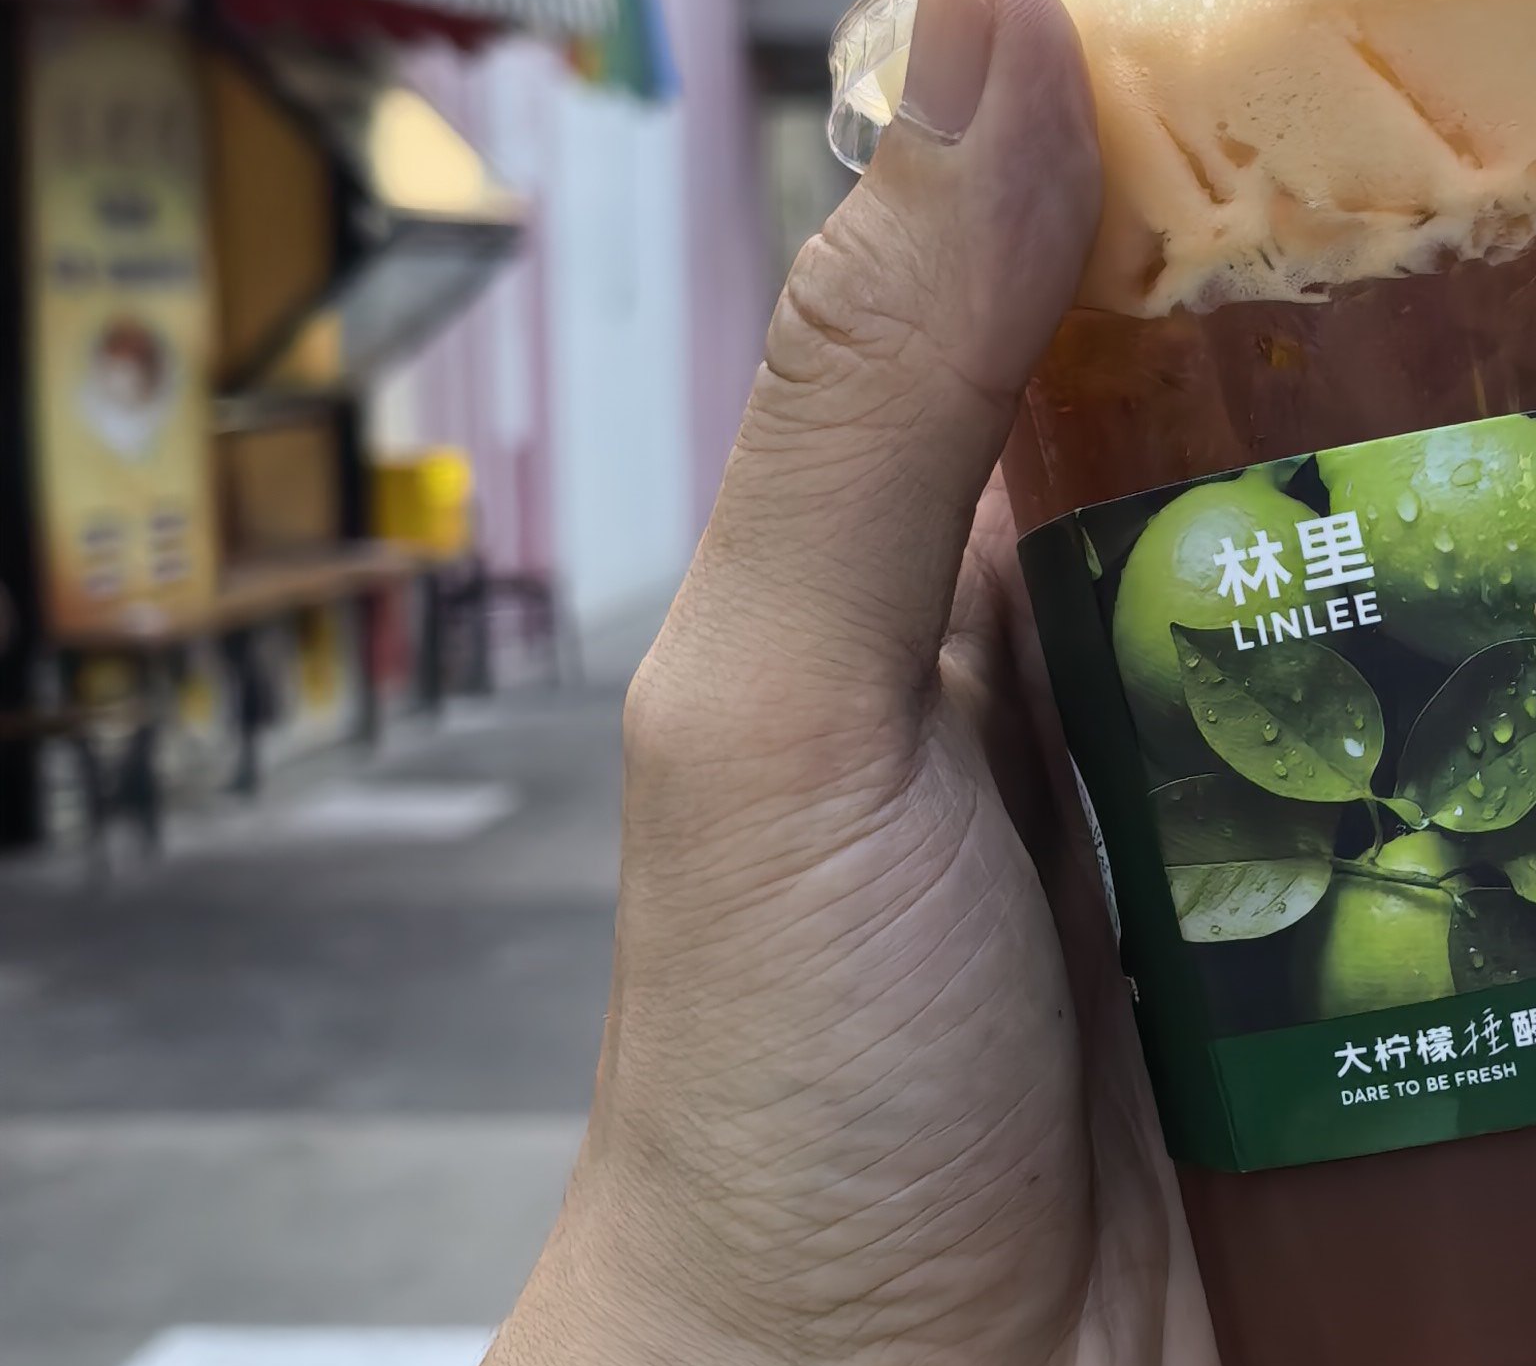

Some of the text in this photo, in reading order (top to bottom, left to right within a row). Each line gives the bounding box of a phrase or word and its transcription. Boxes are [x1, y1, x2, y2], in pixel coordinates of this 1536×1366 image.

[1212, 510, 1376, 606] 林里
[1231, 591, 1383, 651] LINLEE
[1341, 1061, 1518, 1106] DARE TO BE FRESH
